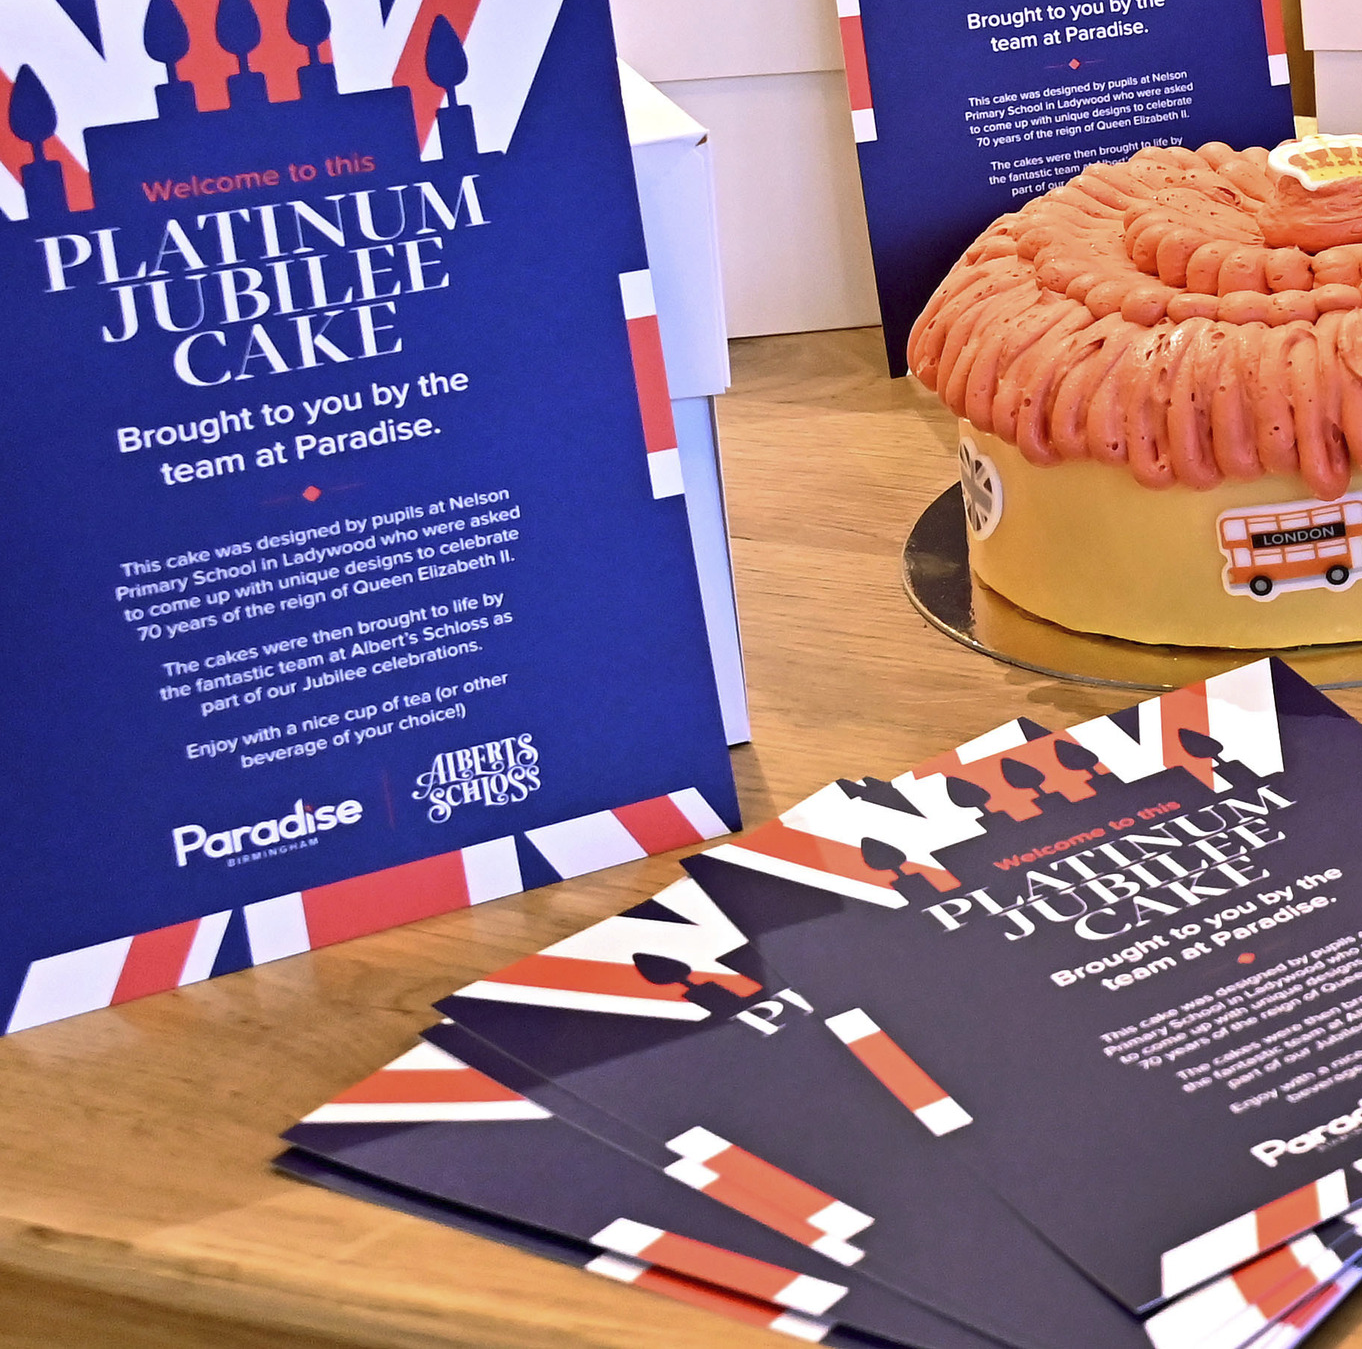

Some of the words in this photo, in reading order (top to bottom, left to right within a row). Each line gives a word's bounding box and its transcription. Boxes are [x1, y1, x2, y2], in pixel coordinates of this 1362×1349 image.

[966, 6, 1044, 30] Brought
[1045, 4, 1066, 20] to
[1069, 1, 1105, 21] you
[989, 34, 1038, 52] team
[1042, 29, 1062, 46] at
[1064, 19, 1149, 43] Paradise.
[967, 96, 991, 107] This
[992, 92, 1018, 104] cake
[1019, 90, 1041, 100] was
[1042, 81, 1091, 97] designed
[1092, 81, 1106, 92] by
[1107, 76, 1138, 90] pupils
[1139, 74, 1151, 85] at
[1151, 70, 1188, 83] Nelson
[141, 169, 280, 203] Welcome
[287, 163, 317, 183] to
[324, 155, 376, 177] this
[35, 173, 491, 292] PLATINUM
[101, 236, 450, 343] JUBILEE
[172, 300, 403, 387] CAKE
[116, 407, 255, 453] Brought
[260, 403, 295, 426] to
[302, 391, 363, 425] you
[371, 382, 410, 409] by
[416, 371, 469, 398] the
[159, 453, 245, 486] team
[255, 441, 288, 468] at
[294, 417, 441, 460] Paradise.
[114, 576, 189, 602] Primary
[192, 559, 257, 586] School
[260, 557, 278, 571] in
[281, 534, 377, 567] Ladywood
[379, 528, 419, 546] who
[421, 519, 466, 537] were
[469, 504, 521, 528] asked
[120, 559, 162, 577] This
[165, 550, 211, 569] cake
[214, 541, 253, 558] was
[255, 520, 341, 550] designed
[344, 518, 367, 534] by
[370, 505, 425, 530] pupils
[428, 500, 446, 515] at
[448, 488, 510, 511] Nelson
[123, 608, 145, 622] to
[148, 596, 201, 617] come
[205, 589, 231, 605] up
[233, 579, 274, 598] with
[277, 566, 340, 590] unique
[343, 551, 414, 575] designs
[415, 546, 436, 560] to
[438, 528, 520, 555] celebrate
[1263, 525, 1335, 547] LONDON
[136, 623, 162, 641] 70
[165, 614, 218, 639] years
[221, 605, 241, 623] of
[244, 602, 276, 619] the
[279, 591, 327, 611] reign
[330, 582, 349, 600] of
[352, 572, 414, 595] Queen
[416, 553, 496, 582] Elizabeth
[499, 548, 515, 564] II.
[162, 660, 200, 677] The
[203, 646, 259, 668] cakes
[261, 636, 308, 656] were
[311, 625, 354, 645] then
[356, 607, 428, 635] brought
[429, 604, 449, 618] to
[452, 596, 479, 613] life
[481, 592, 504, 608] by
[159, 684, 192, 701] the
[195, 664, 275, 692] fantastic
[277, 653, 324, 674] team
[328, 647, 347, 663] at
[350, 631, 419, 658] Albert's
[422, 616, 489, 642] Schloss
[492, 611, 513, 626] as
[200, 693, 240, 717] part
[243, 686, 262, 704] of
[266, 681, 297, 699] our
[302, 666, 367, 691] Jubilee
[371, 640, 483, 675] celebrations.
[185, 737, 238, 760] Enjoy
[241, 725, 282, 745] with
[285, 723, 298, 736] a
[301, 713, 340, 732] nice
[343, 704, 378, 722] cup
[381, 695, 399, 713] of
[402, 691, 432, 708] tea
[434, 684, 459, 703] (or
[462, 673, 508, 693] other
[240, 738, 328, 769] beverage
[332, 728, 351, 747] of
[353, 721, 394, 745] your
[398, 702, 466, 731] choice!)
[171, 795, 364, 868] Paradise
[426, 765, 541, 824] SCHLOSS
[992, 827, 1106, 871] Welcome
[1107, 817, 1135, 831] to
[1136, 801, 1181, 820] this
[227, 837, 320, 868] BIRMINGHAM
[921, 784, 1297, 932] PLATINUM
[999, 817, 1286, 941] JUBILEE
[1049, 934, 1170, 987] Brought
[1168, 923, 1202, 940] to
[1202, 900, 1258, 930] you
[1256, 885, 1294, 906] by
[1295, 867, 1343, 890] the
[1073, 854, 1271, 941] CAKE
[1101, 956, 1177, 991] team
[1180, 941, 1212, 960] at
[1209, 895, 1337, 947] Paradise.
